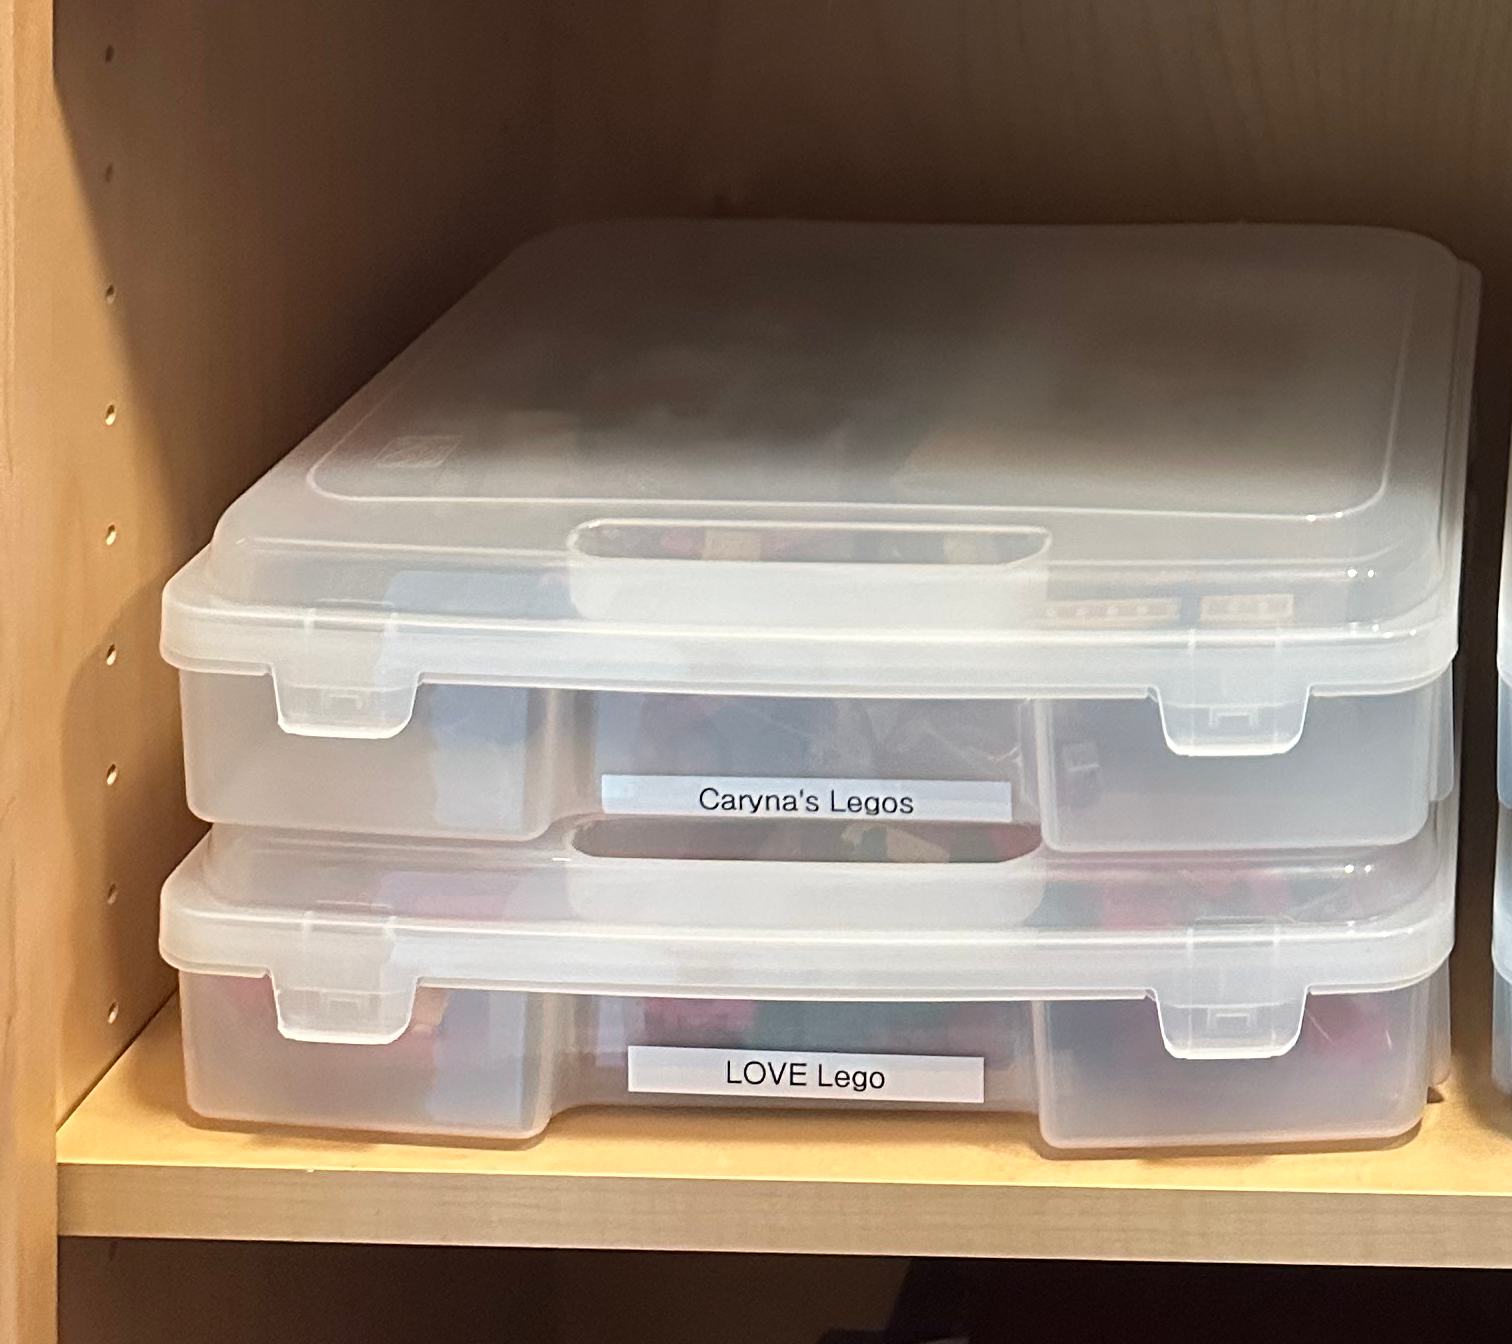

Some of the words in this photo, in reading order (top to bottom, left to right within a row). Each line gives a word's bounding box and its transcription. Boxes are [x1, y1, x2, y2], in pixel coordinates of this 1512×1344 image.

[698, 786, 821, 815] Caryna's
[830, 788, 915, 817] Legos
[726, 1059, 808, 1088] LOVE
[817, 1062, 886, 1094] Lego
